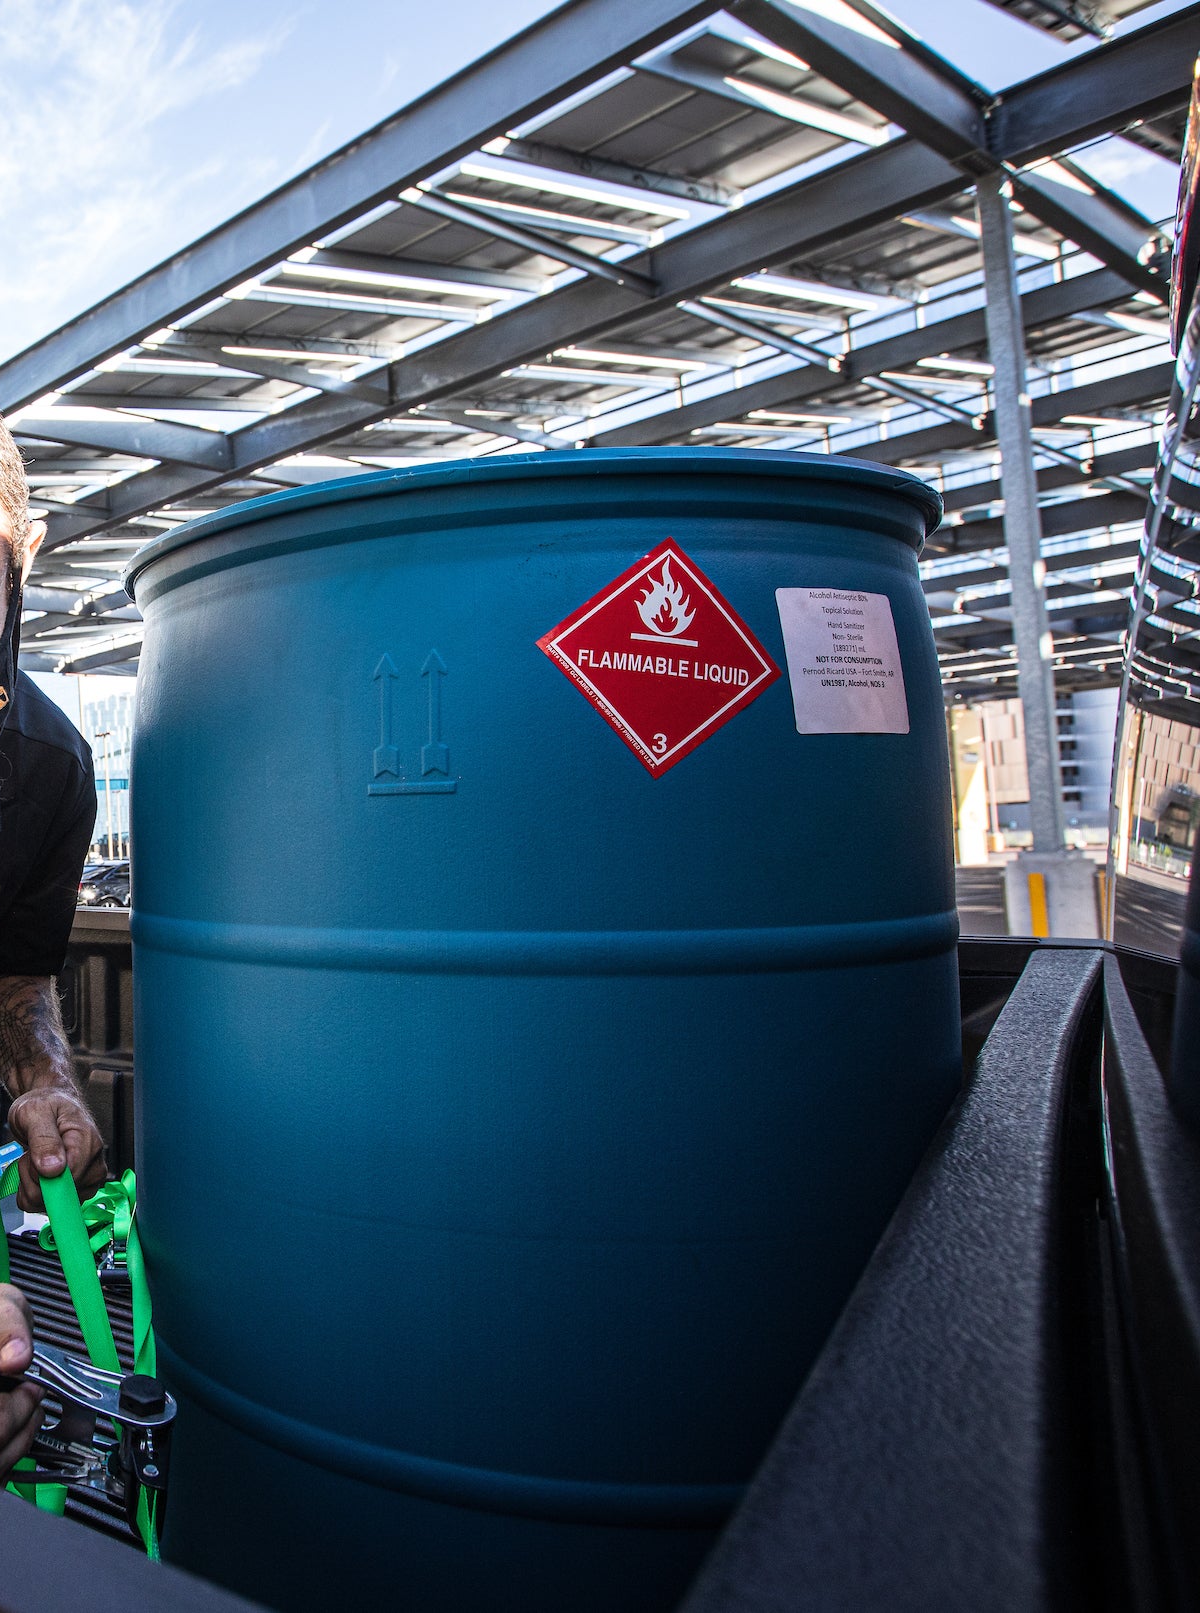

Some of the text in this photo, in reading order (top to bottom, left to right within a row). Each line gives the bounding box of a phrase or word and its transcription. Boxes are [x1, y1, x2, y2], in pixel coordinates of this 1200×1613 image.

[809, 591, 869, 602] Alcohol Antiseptic 80%
[822, 606, 864, 616] Topical Solution
[844, 622, 865, 630] Sanitizer
[847, 634, 864, 642] Sterile
[844, 656, 882, 666] CONSUMPTION
[577, 649, 750, 687] FLAMMABLE LIQUID
[822, 680, 848, 688] UN1987,
[623, 729, 640, 751] PRINTED
[652, 733, 668, 754] 3
